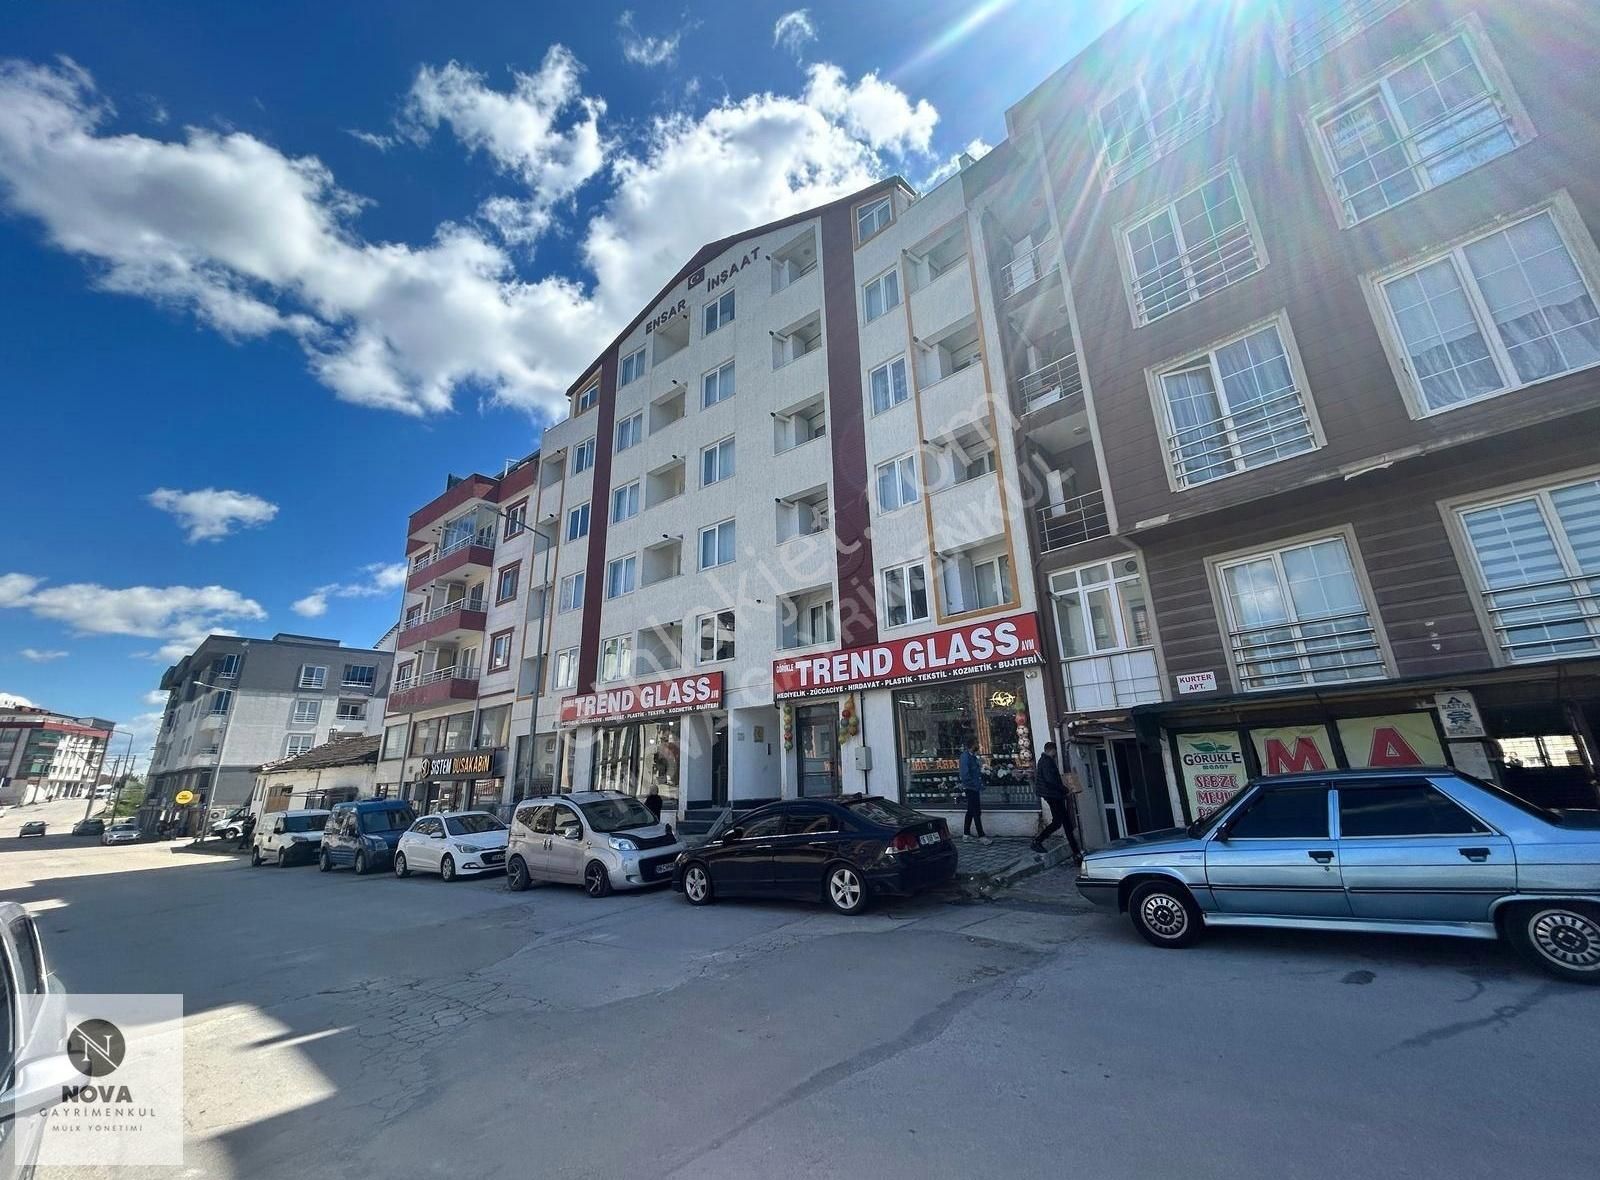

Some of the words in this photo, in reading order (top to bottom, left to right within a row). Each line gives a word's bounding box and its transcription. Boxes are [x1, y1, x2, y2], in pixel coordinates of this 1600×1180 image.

[646, 299, 686, 335] ENSAR
[796, 647, 893, 687] TREND
[902, 622, 1020, 672] GLASS
[575, 690, 635, 717] TREND
[640, 676, 712, 709] GLASS
[1179, 674, 1212, 684] KURTER
[1189, 683, 1206, 691] APT.
[1368, 725, 1425, 767] A
[1195, 774, 1239, 790] SEBZE
